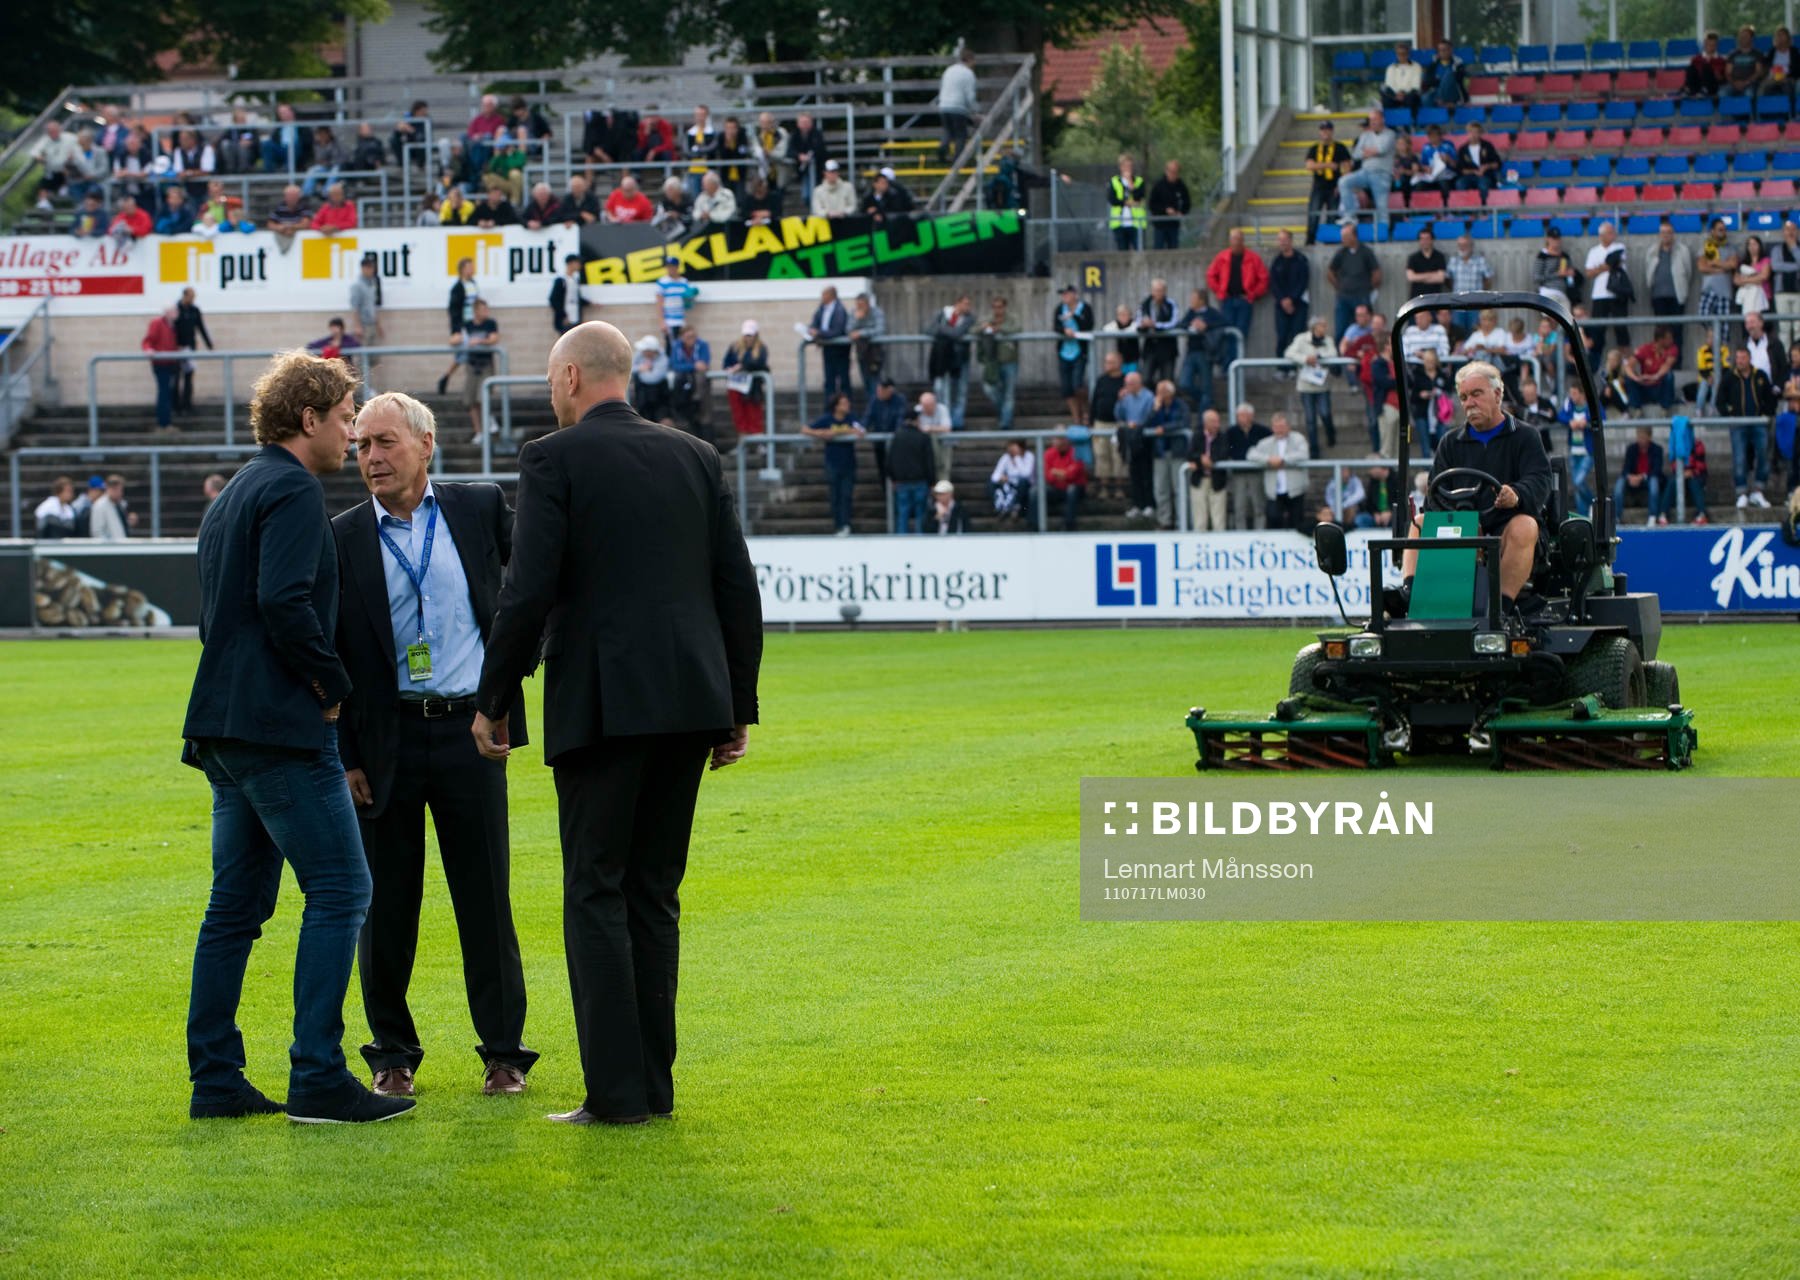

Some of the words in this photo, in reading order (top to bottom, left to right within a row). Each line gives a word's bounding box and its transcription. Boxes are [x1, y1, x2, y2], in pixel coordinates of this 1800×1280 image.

[585, 215, 833, 285] REKLAM
[767, 208, 1021, 280] ATELJEN
[1085, 266, 1102, 288] R
[1709, 527, 1800, 609] Kin
